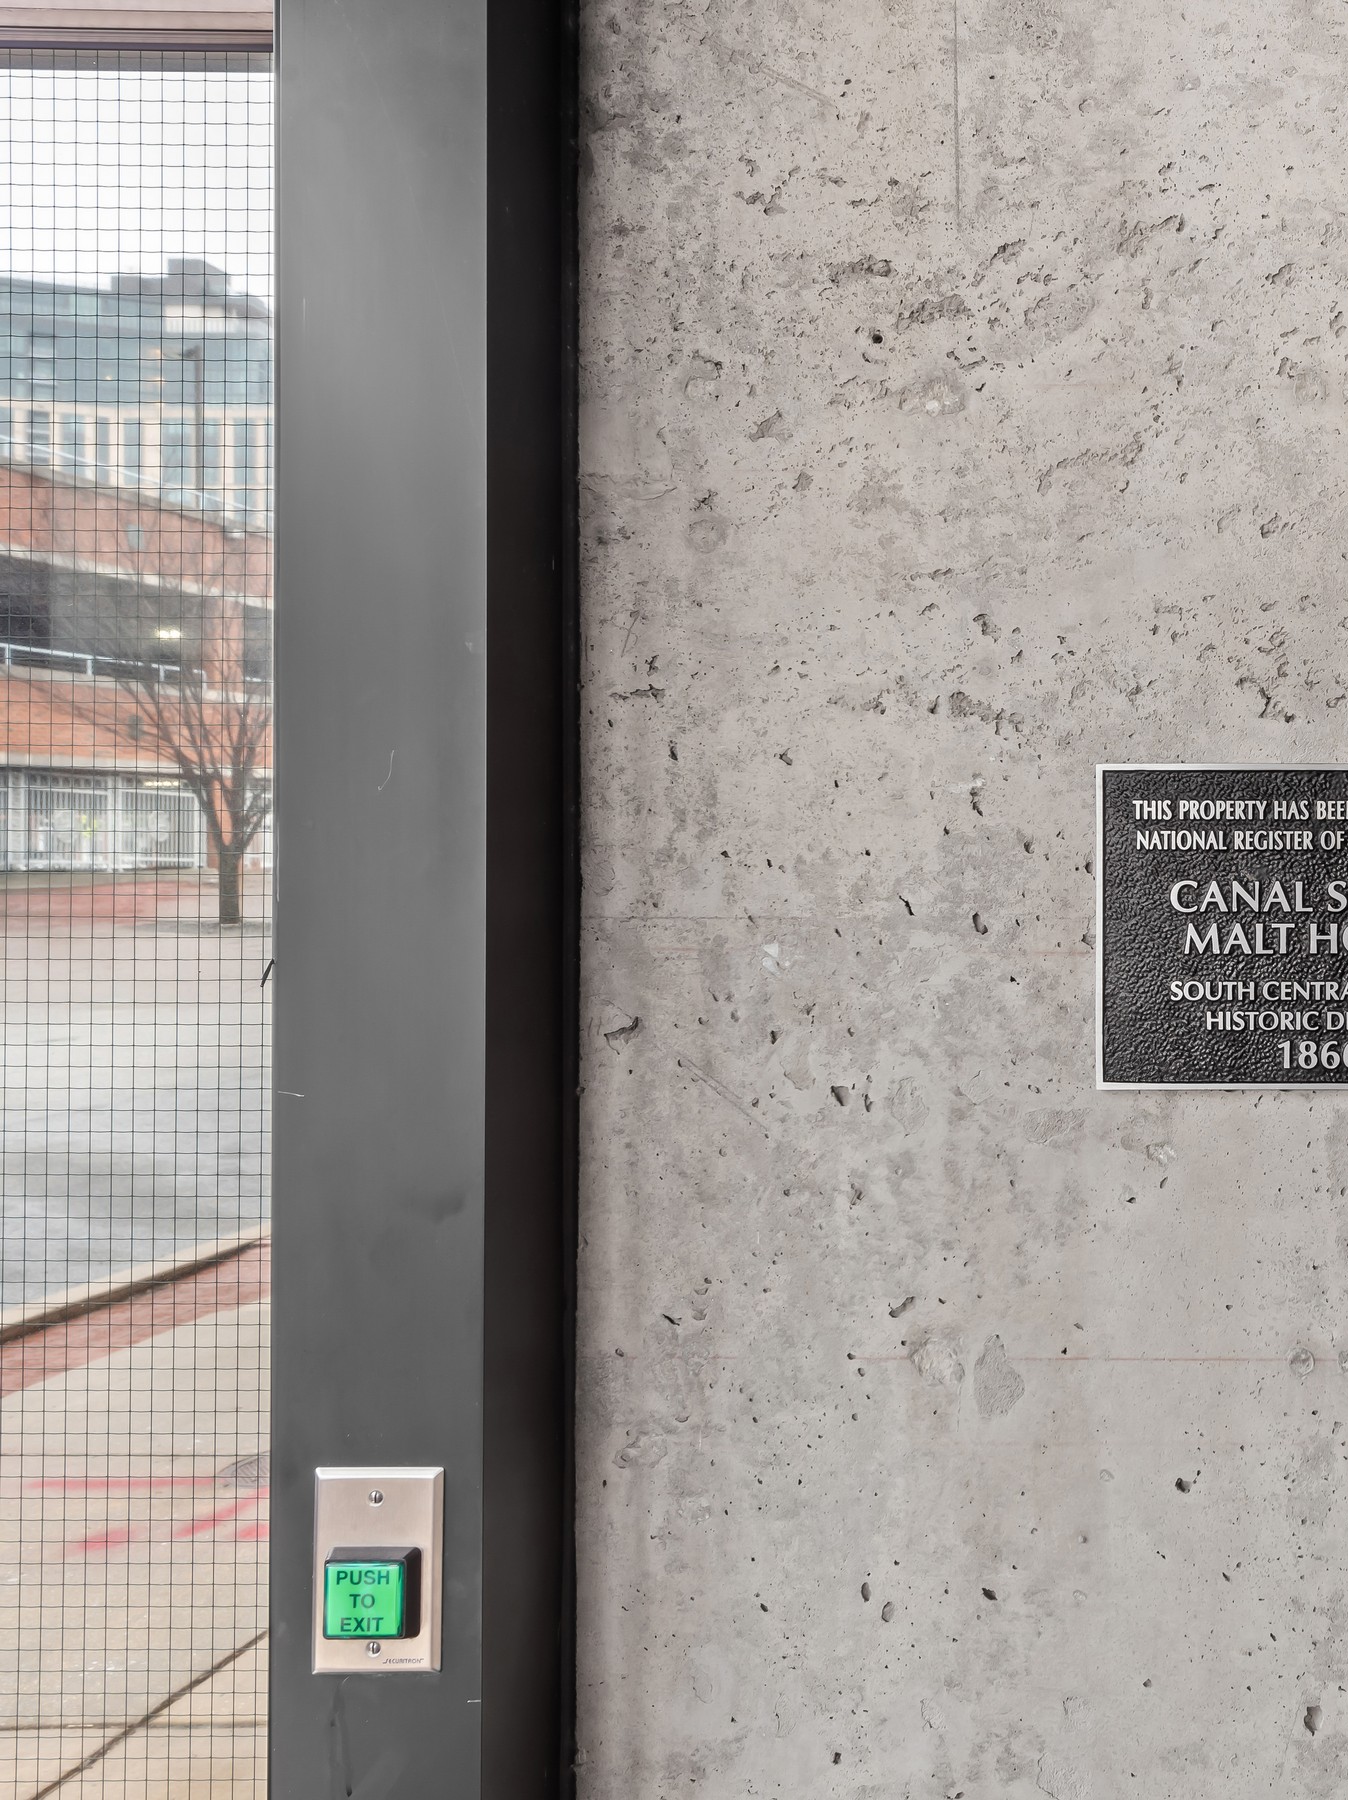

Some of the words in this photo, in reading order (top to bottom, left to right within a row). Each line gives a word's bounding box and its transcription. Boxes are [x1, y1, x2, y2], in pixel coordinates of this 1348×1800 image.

[1132, 799, 1172, 821] THIS
[1179, 799, 1267, 821] PROPERTY
[1273, 799, 1309, 821] HAS
[1136, 830, 1227, 850] NATIONAL
[1234, 830, 1314, 850] REGISTER
[1320, 830, 1345, 850] OF
[1169, 880, 1313, 913] CANAL
[1183, 922, 1296, 956] MALT
[1169, 980, 1256, 1001] SOUTH
[1205, 1011, 1319, 1032] HISTORIC
[336, 1570, 390, 1586] PUSH
[349, 1593, 376, 1609] TO
[340, 1617, 384, 1633] EXIT
